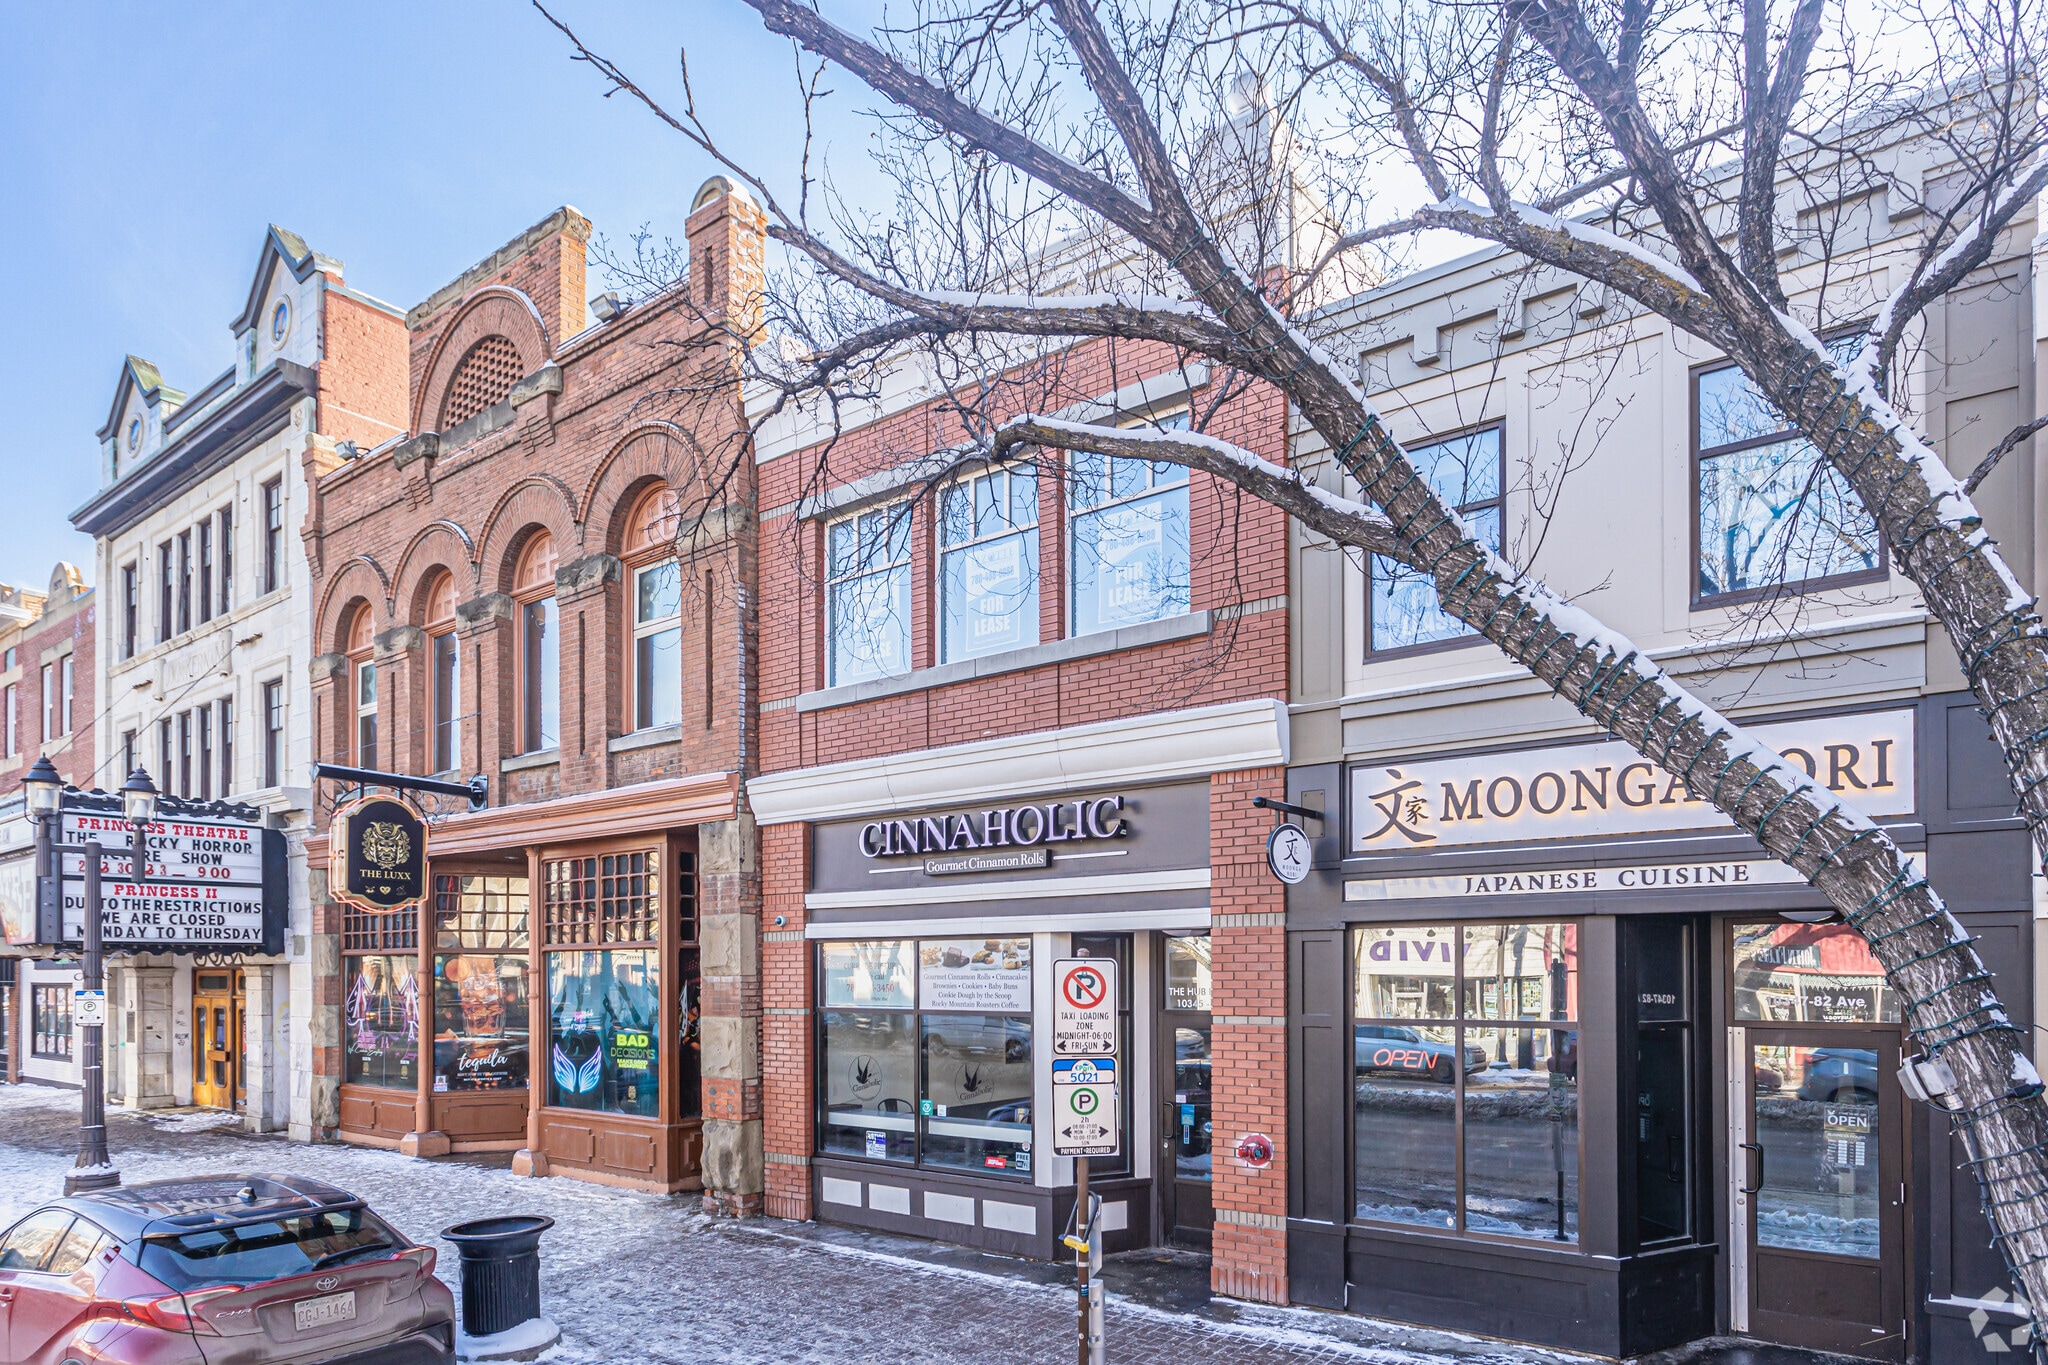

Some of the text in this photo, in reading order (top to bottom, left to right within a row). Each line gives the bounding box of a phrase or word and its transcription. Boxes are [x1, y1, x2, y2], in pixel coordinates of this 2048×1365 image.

[1115, 562, 1143, 584] FOR
[980, 595, 1004, 613] FOR
[974, 614, 1011, 637] LEASE
[1439, 739, 1894, 822] MOONGAORI
[78, 817, 248, 840] PRINCSS THEATRE
[858, 795, 1125, 858] CINNAHOLIC
[126, 835, 179, 850] RCKY
[192, 839, 252, 854] HORROR
[182, 852, 222, 865] SHOW
[926, 853, 1044, 874] Gourmet Cinnamon Rolls
[360, 869, 411, 880] THE LUXX
[1465, 864, 1750, 895] JAPANESE CUISINE
[114, 884, 217, 898] PRINCESS II
[64, 896, 84, 909] DU
[122, 898, 150, 910] THE
[102, 912, 225, 926] WE ARE CLOSED
[77, 926, 261, 940] MNDAY TO THURSDAY
[988, 983, 1002, 991] Baby
[1168, 988, 1184, 996] THE
[1187, 988, 1206, 996] HUB
[1176, 999, 1204, 1008] 10345
[1767, 996, 1833, 1008] 10347-82
[1061, 1012, 1109, 1020] TAXI LOADING
[1076, 1022, 1094, 1030] ZONE
[616, 1034, 648, 1046] BAD
[1056, 1032, 1112, 1040] MIDNIGHT-06:00
[1072, 1042, 1098, 1050] FRI-SUN
[456, 1048, 508, 1071] tequila
[1373, 1048, 1439, 1070] OPEN
[1070, 1072, 1098, 1082] 5021
[1828, 1115, 1868, 1128] OPEN
[216, 1308, 252, 1318] C-HR
[298, 1300, 354, 1324] CGJ-1464
